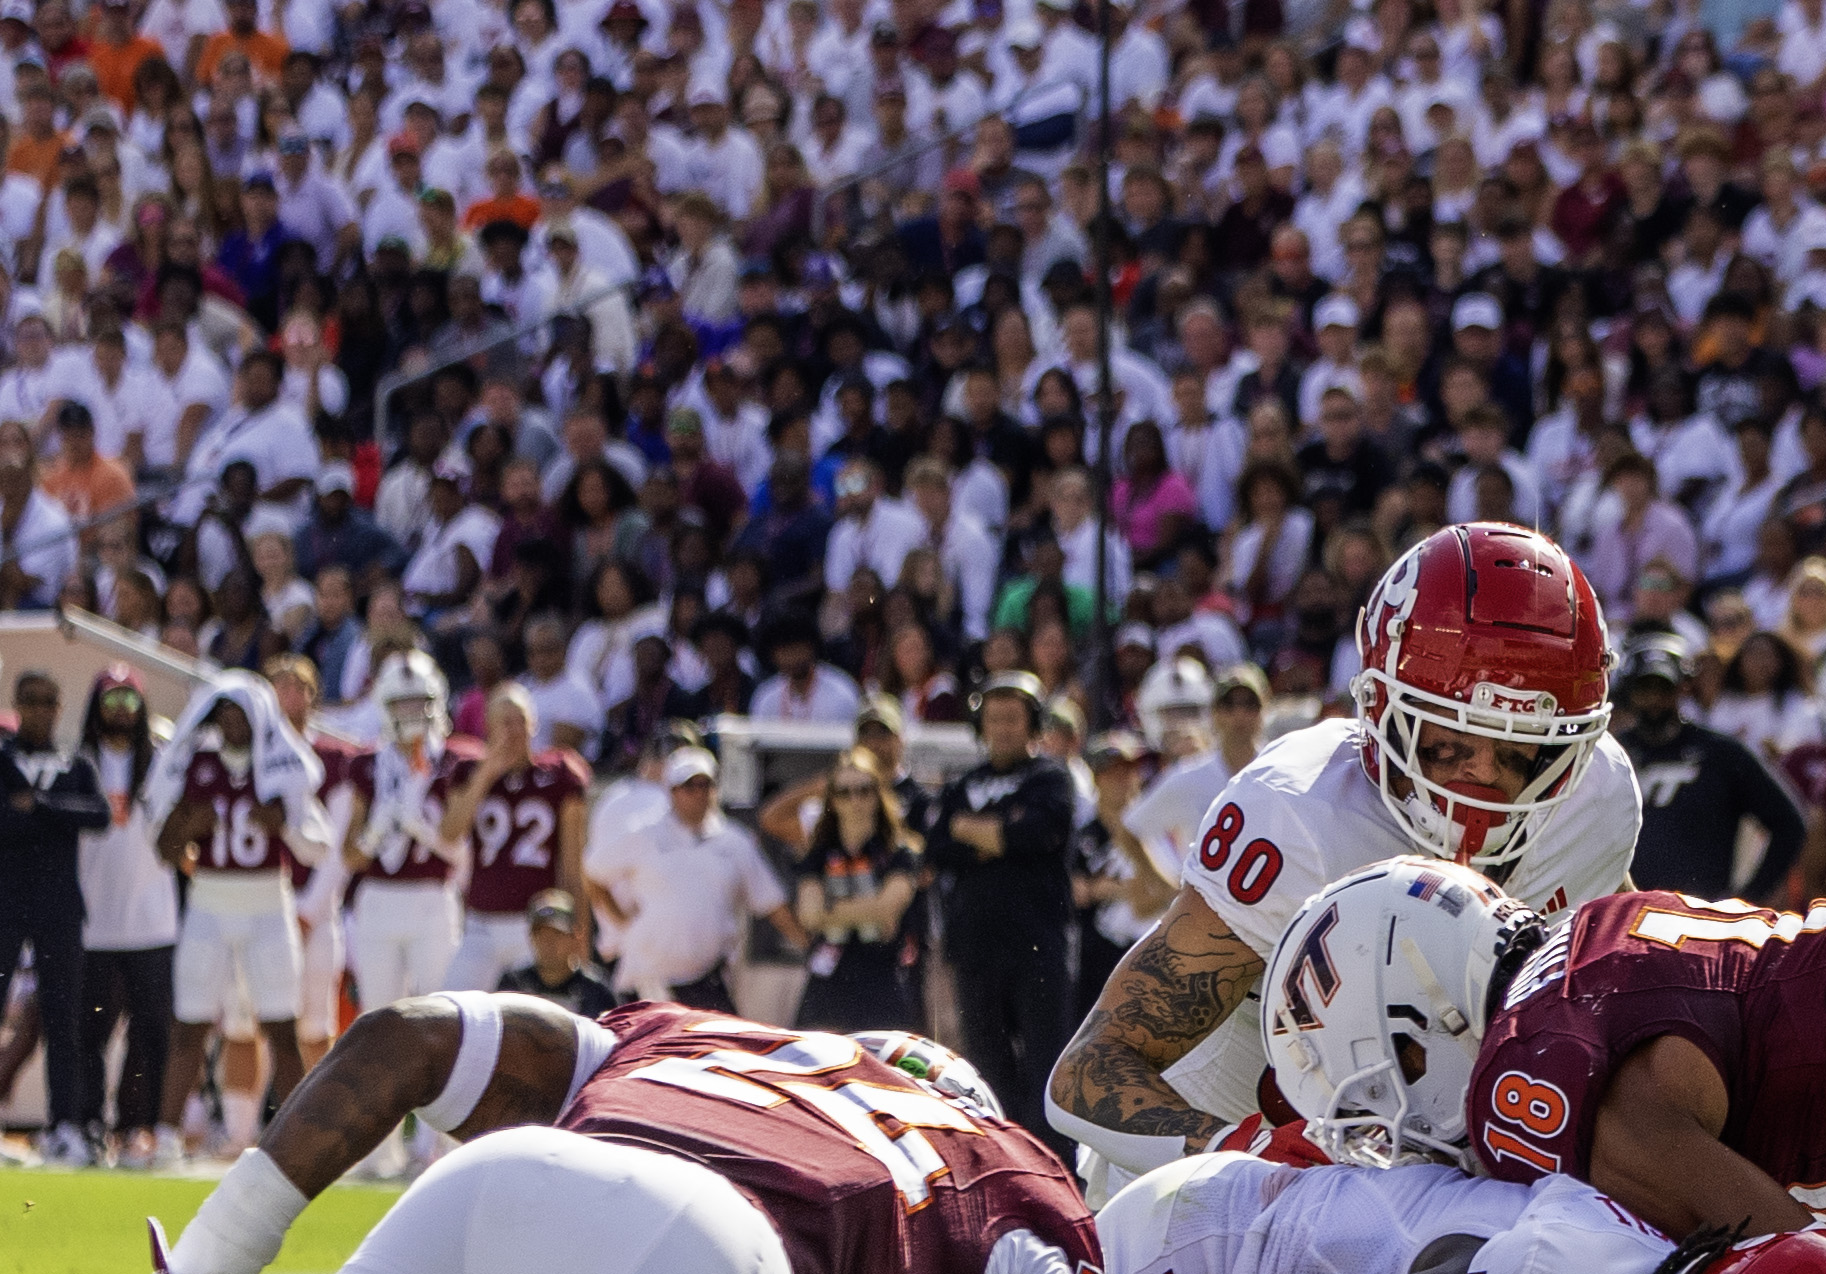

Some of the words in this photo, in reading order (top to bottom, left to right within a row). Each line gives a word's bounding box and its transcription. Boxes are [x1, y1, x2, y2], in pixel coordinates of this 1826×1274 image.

[211, 794, 269, 868] 16
[474, 796, 556, 869] 92
[1200, 802, 1284, 905] 80
[1484, 1070, 1570, 1174] 18
